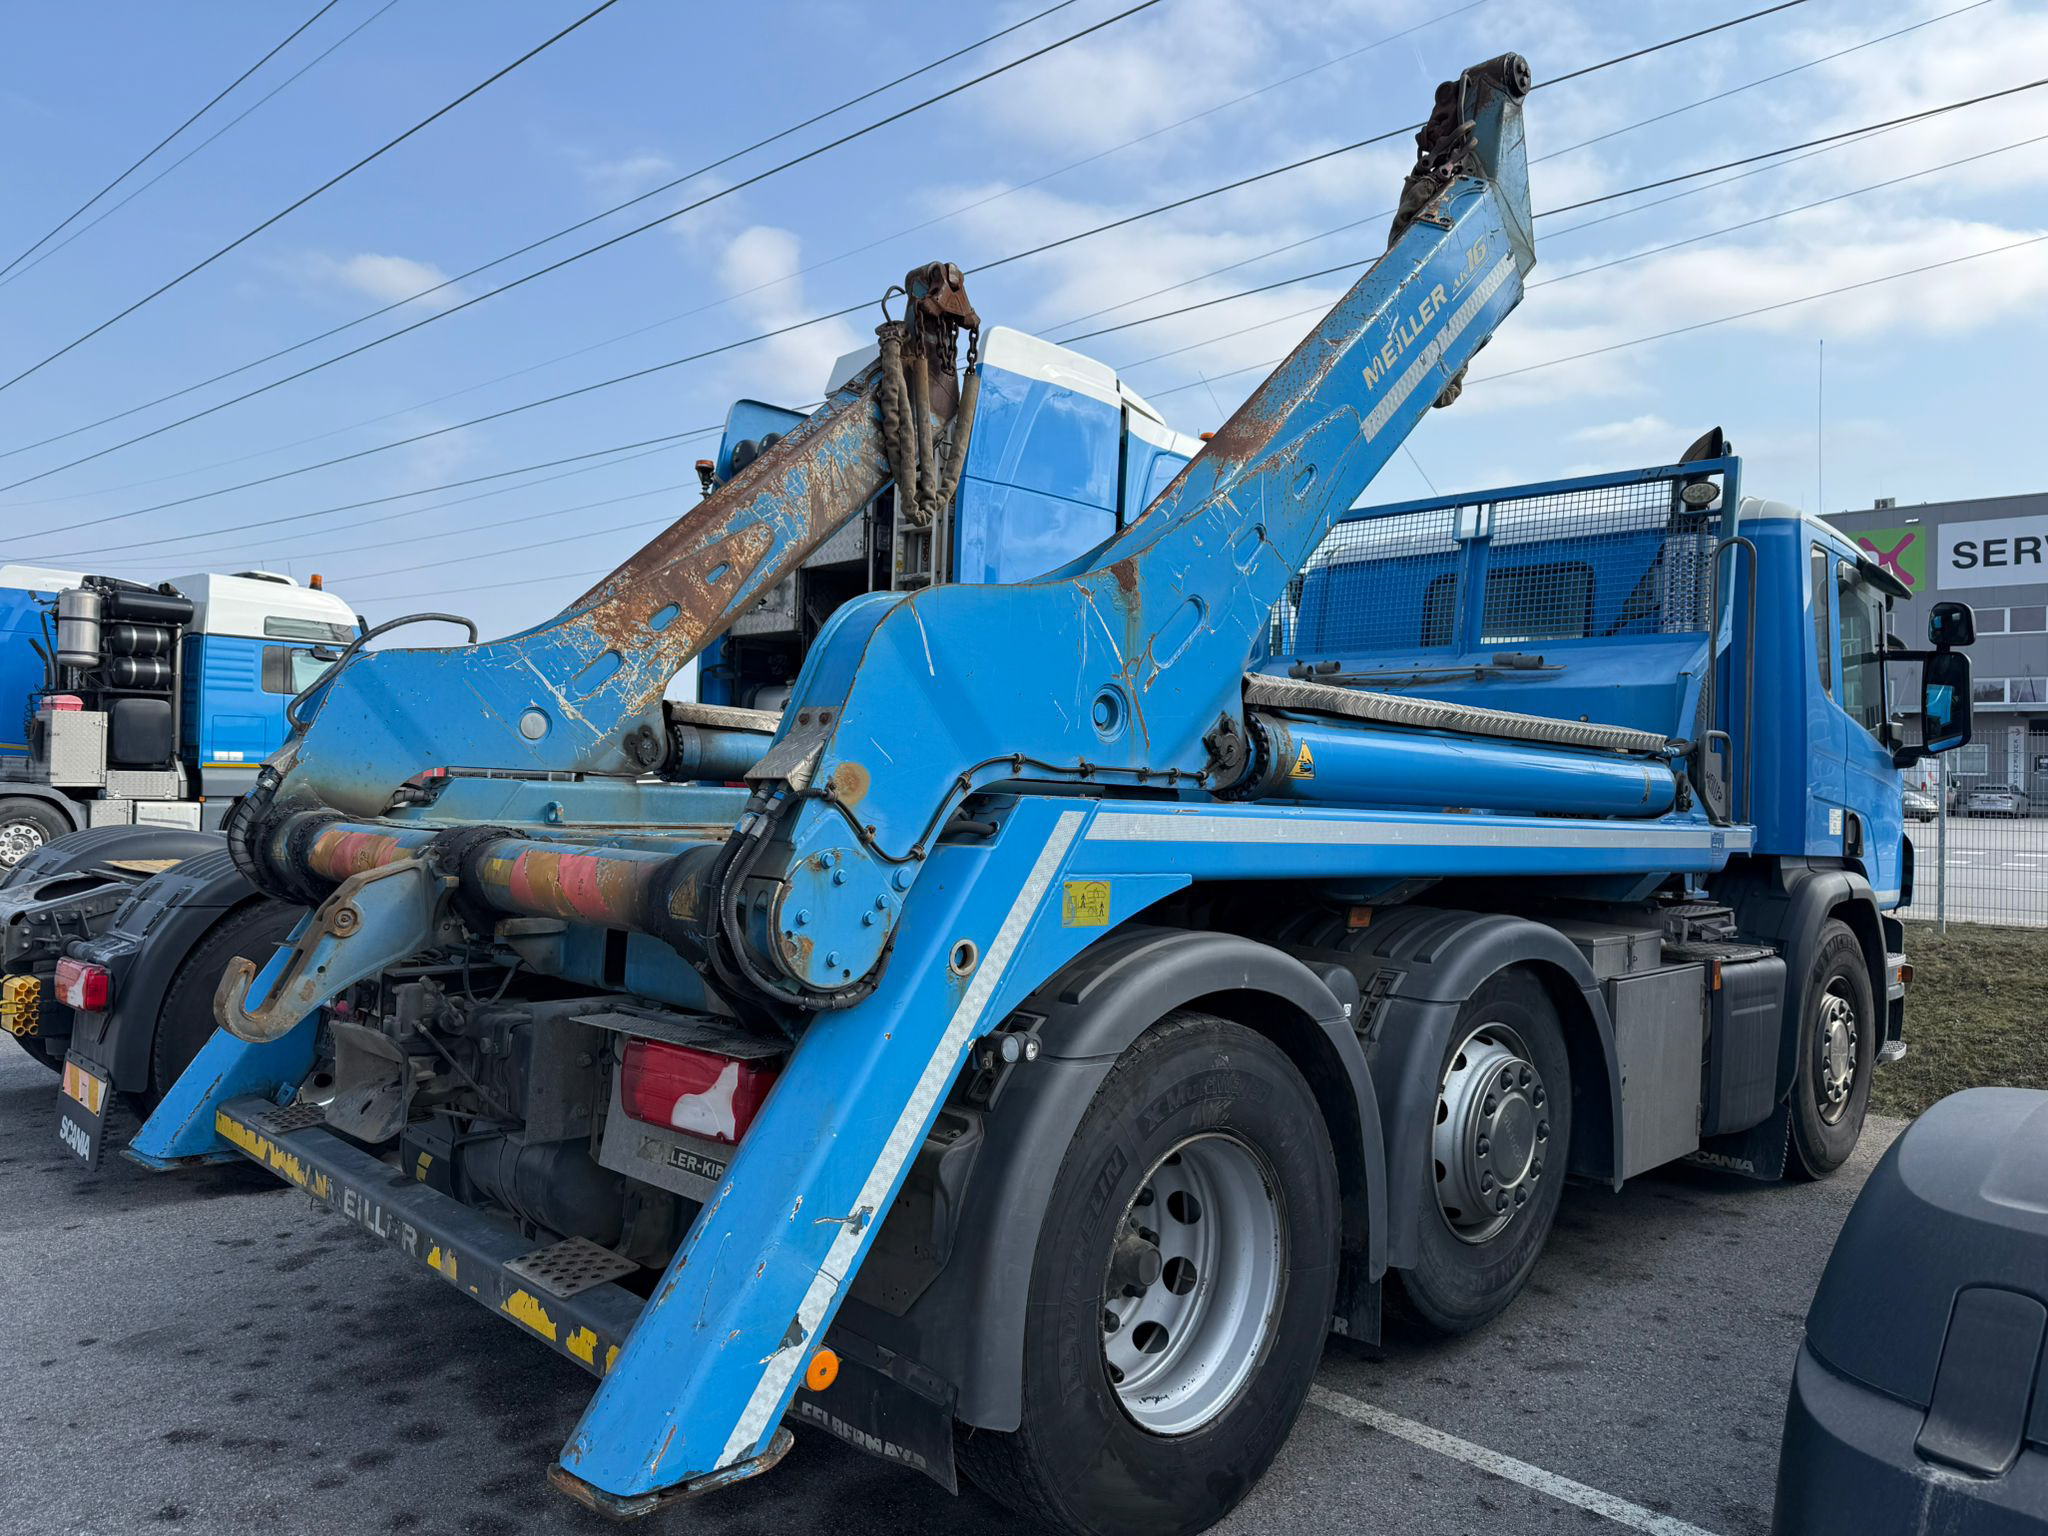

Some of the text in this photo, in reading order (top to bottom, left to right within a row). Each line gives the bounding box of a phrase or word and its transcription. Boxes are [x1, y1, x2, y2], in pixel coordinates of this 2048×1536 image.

[1362, 283, 1448, 391] MEILLER
[1952, 534, 2048, 570] SER
[59, 1114, 91, 1162] SCANIA
[328, 1179, 418, 1258] EILLR
